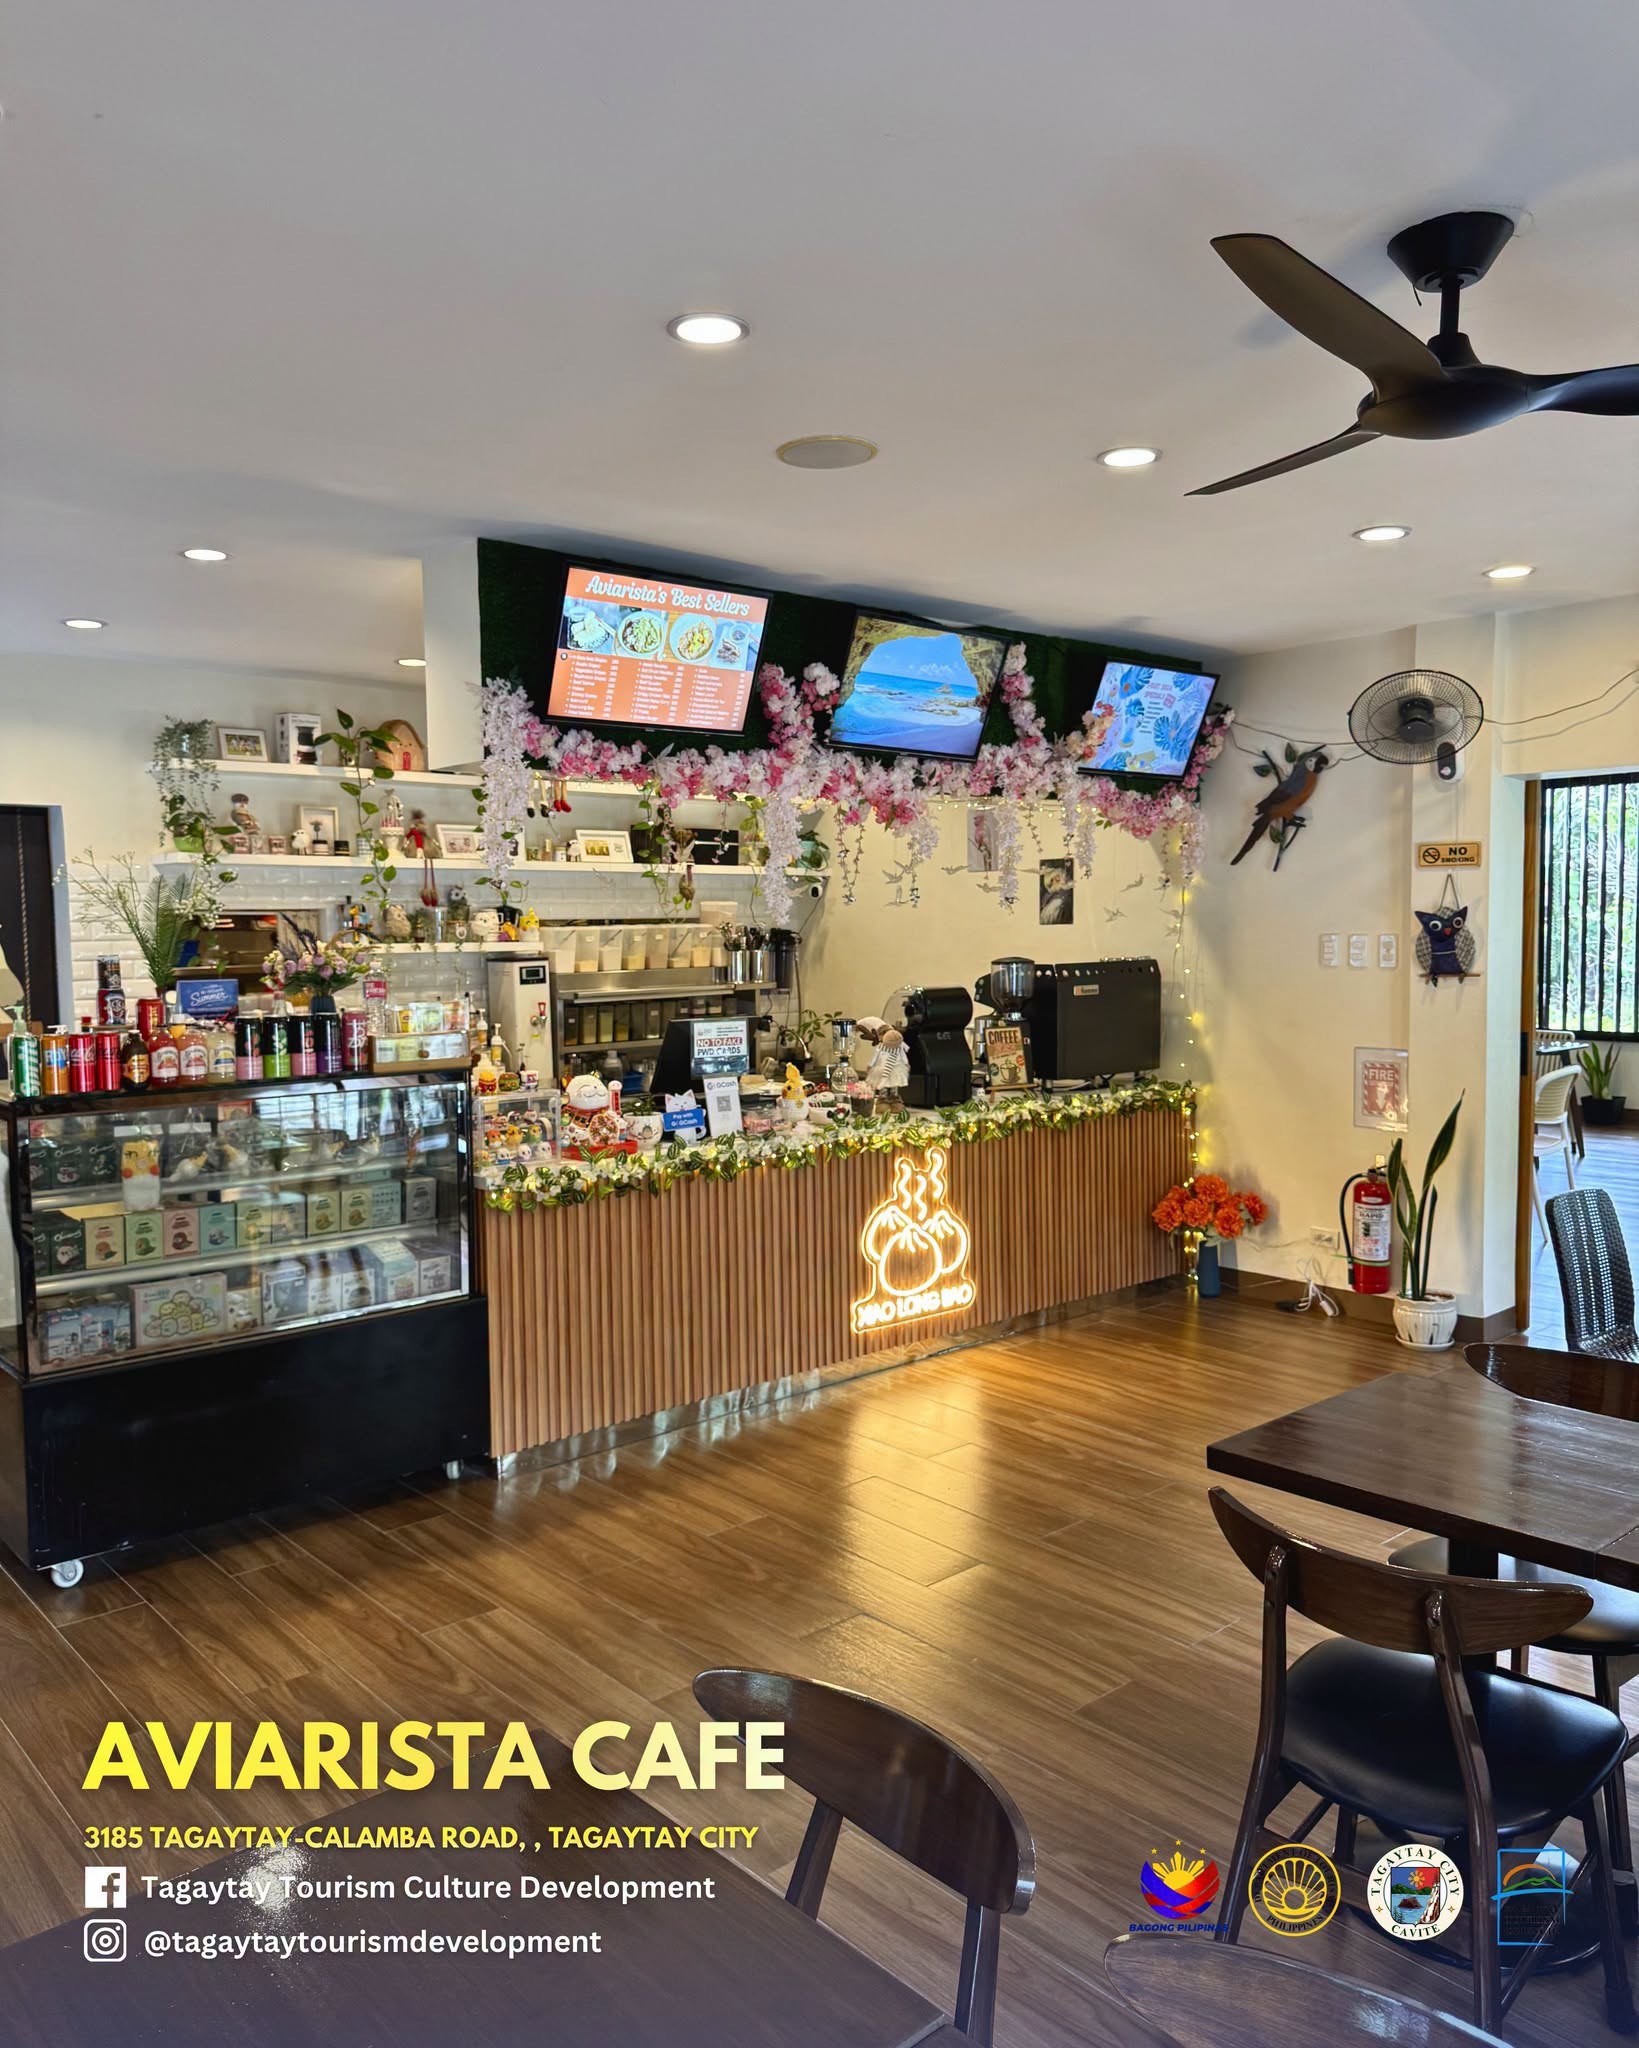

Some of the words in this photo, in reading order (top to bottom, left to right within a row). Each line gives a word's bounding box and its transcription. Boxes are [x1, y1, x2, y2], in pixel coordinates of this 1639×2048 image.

[584, 575, 668, 604] Aviarista's
[671, 587, 703, 609] Best
[704, 592, 750, 616] Sellers
[1448, 847, 1468, 856] NO
[190, 992, 228, 1007] Summer
[697, 1039, 709, 1047] NO
[711, 1038, 722, 1046] TO
[723, 1037, 742, 1046] FAKE
[988, 1030, 1018, 1045] COFFEE
[697, 1048, 715, 1056] PWD
[1369, 1068, 1394, 1081] FIRE
